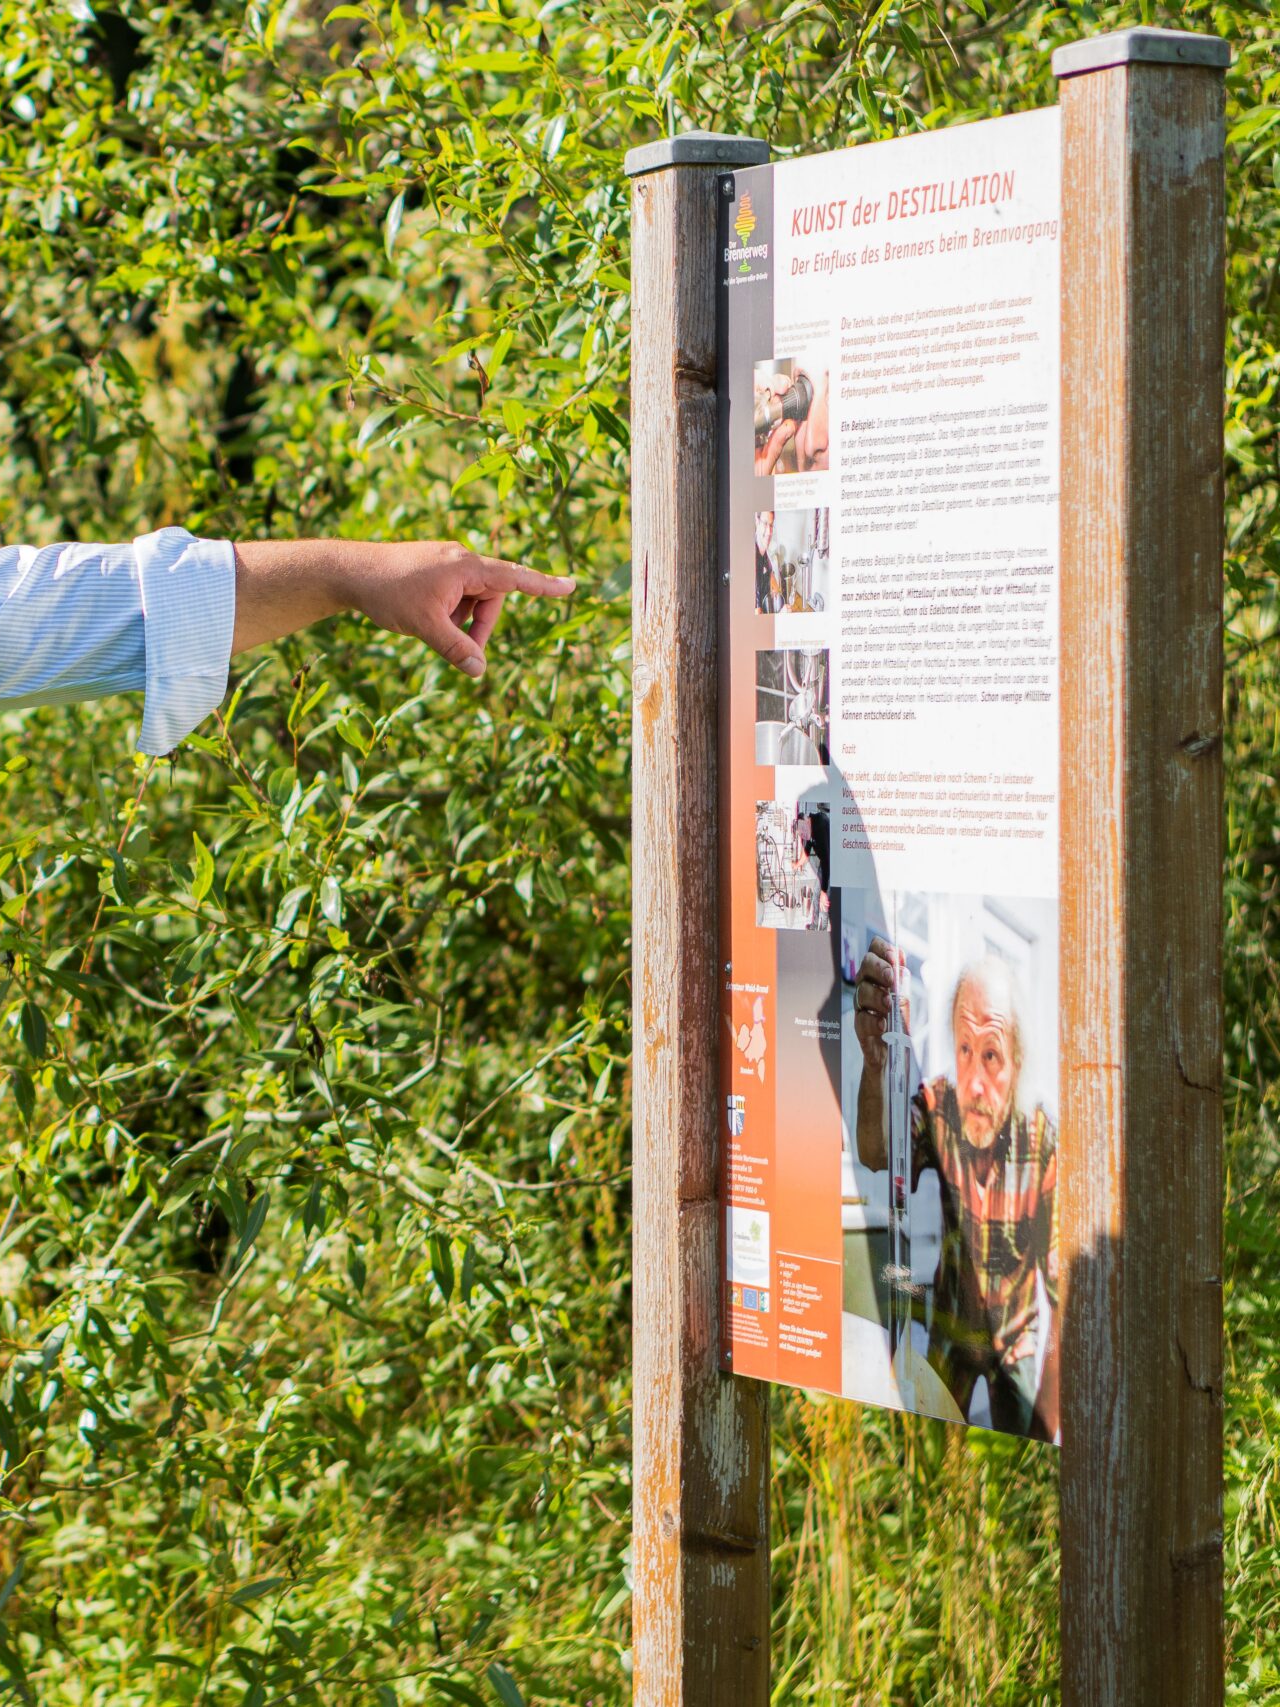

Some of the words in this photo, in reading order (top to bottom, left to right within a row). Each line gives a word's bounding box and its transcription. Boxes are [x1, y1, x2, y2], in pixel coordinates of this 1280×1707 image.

[791, 200, 847, 236] KUNST
[852, 196, 880, 226] der
[887, 170, 1015, 220] DESTILLATION
[724, 244, 768, 262] Brennerweg
[791, 256, 810, 275] Der
[813, 250, 857, 275] Einfluss
[861, 246, 880, 265] des
[884, 238, 934, 261] Brenners
[939, 231, 968, 252] beim
[973, 220, 1059, 248] Brennvorgang
[851, 418, 875, 432] Beispiel:
[841, 710, 861, 720] können
[863, 709, 901, 720] entscheidend
[902, 709, 915, 720] sein.
[842, 743, 855, 754] Fazit
